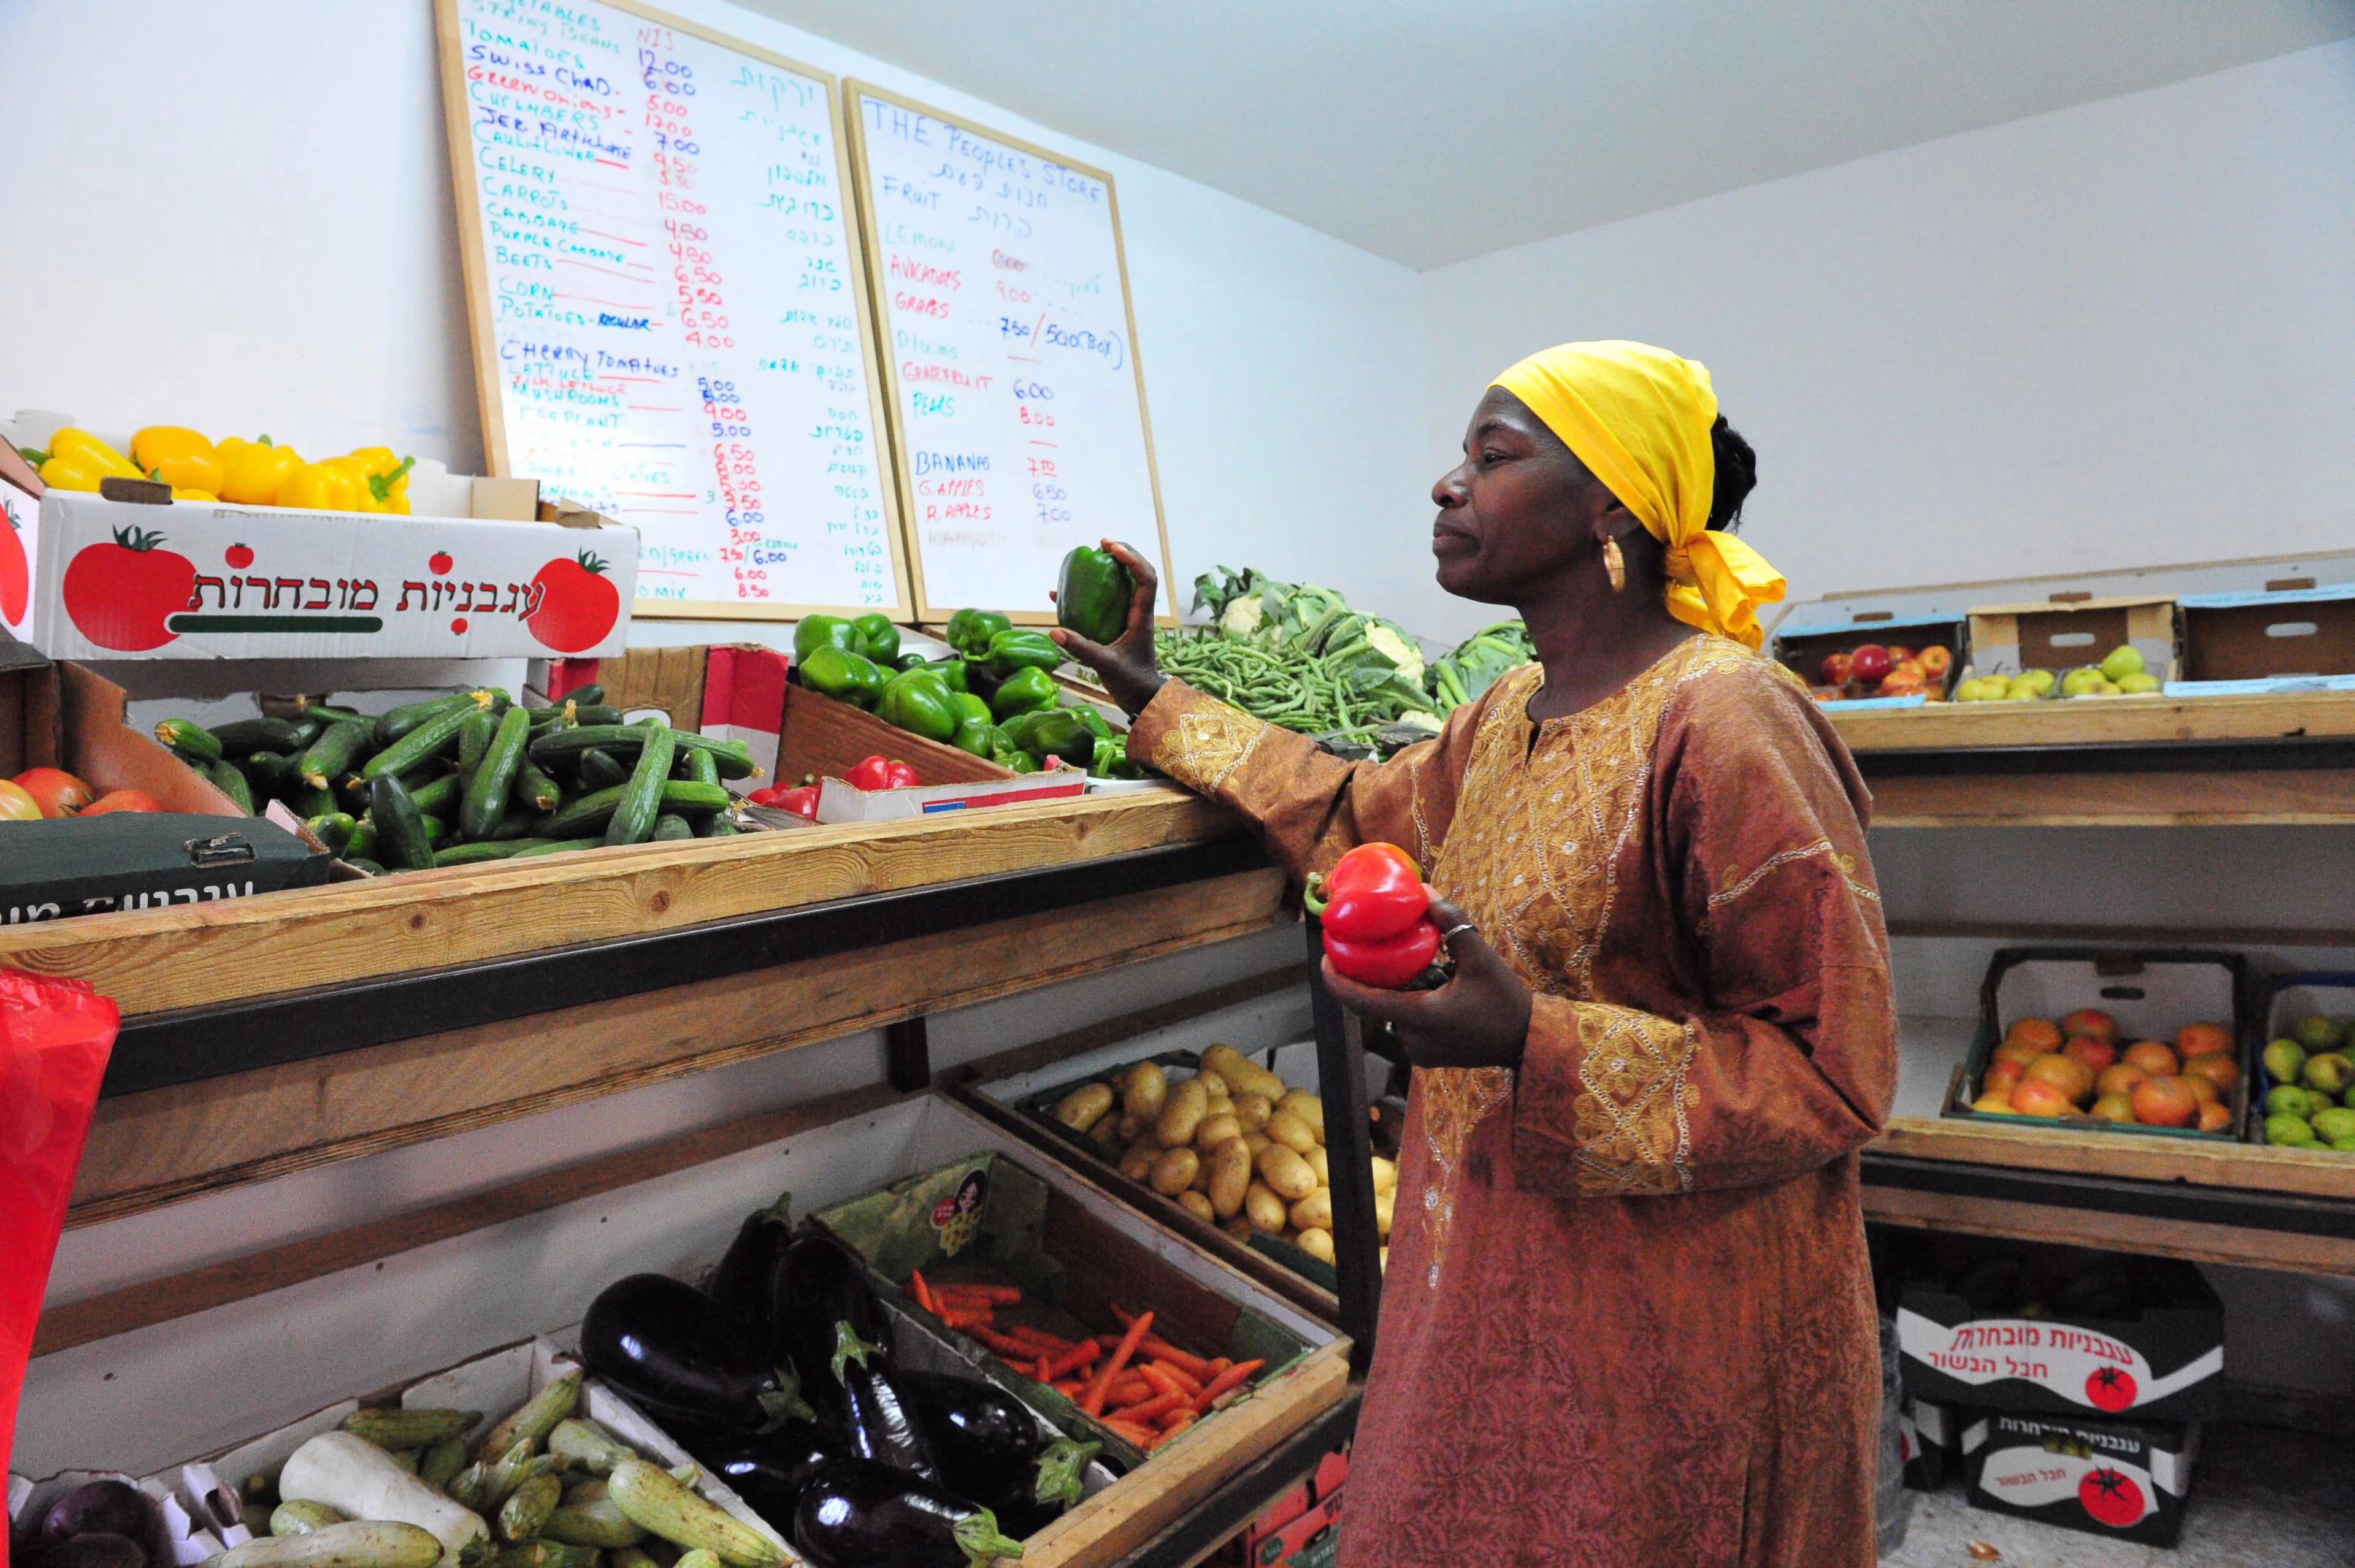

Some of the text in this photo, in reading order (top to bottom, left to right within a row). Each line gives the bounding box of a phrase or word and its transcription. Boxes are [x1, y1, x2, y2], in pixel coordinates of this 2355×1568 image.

[864, 99, 930, 147] THE
[883, 175, 942, 210] FRUIT
[499, 275, 554, 301] CORN
[186, 575, 545, 622] עגבניות מובחרות
[1950, 1327, 2134, 1366] עגבניות מובחרות
